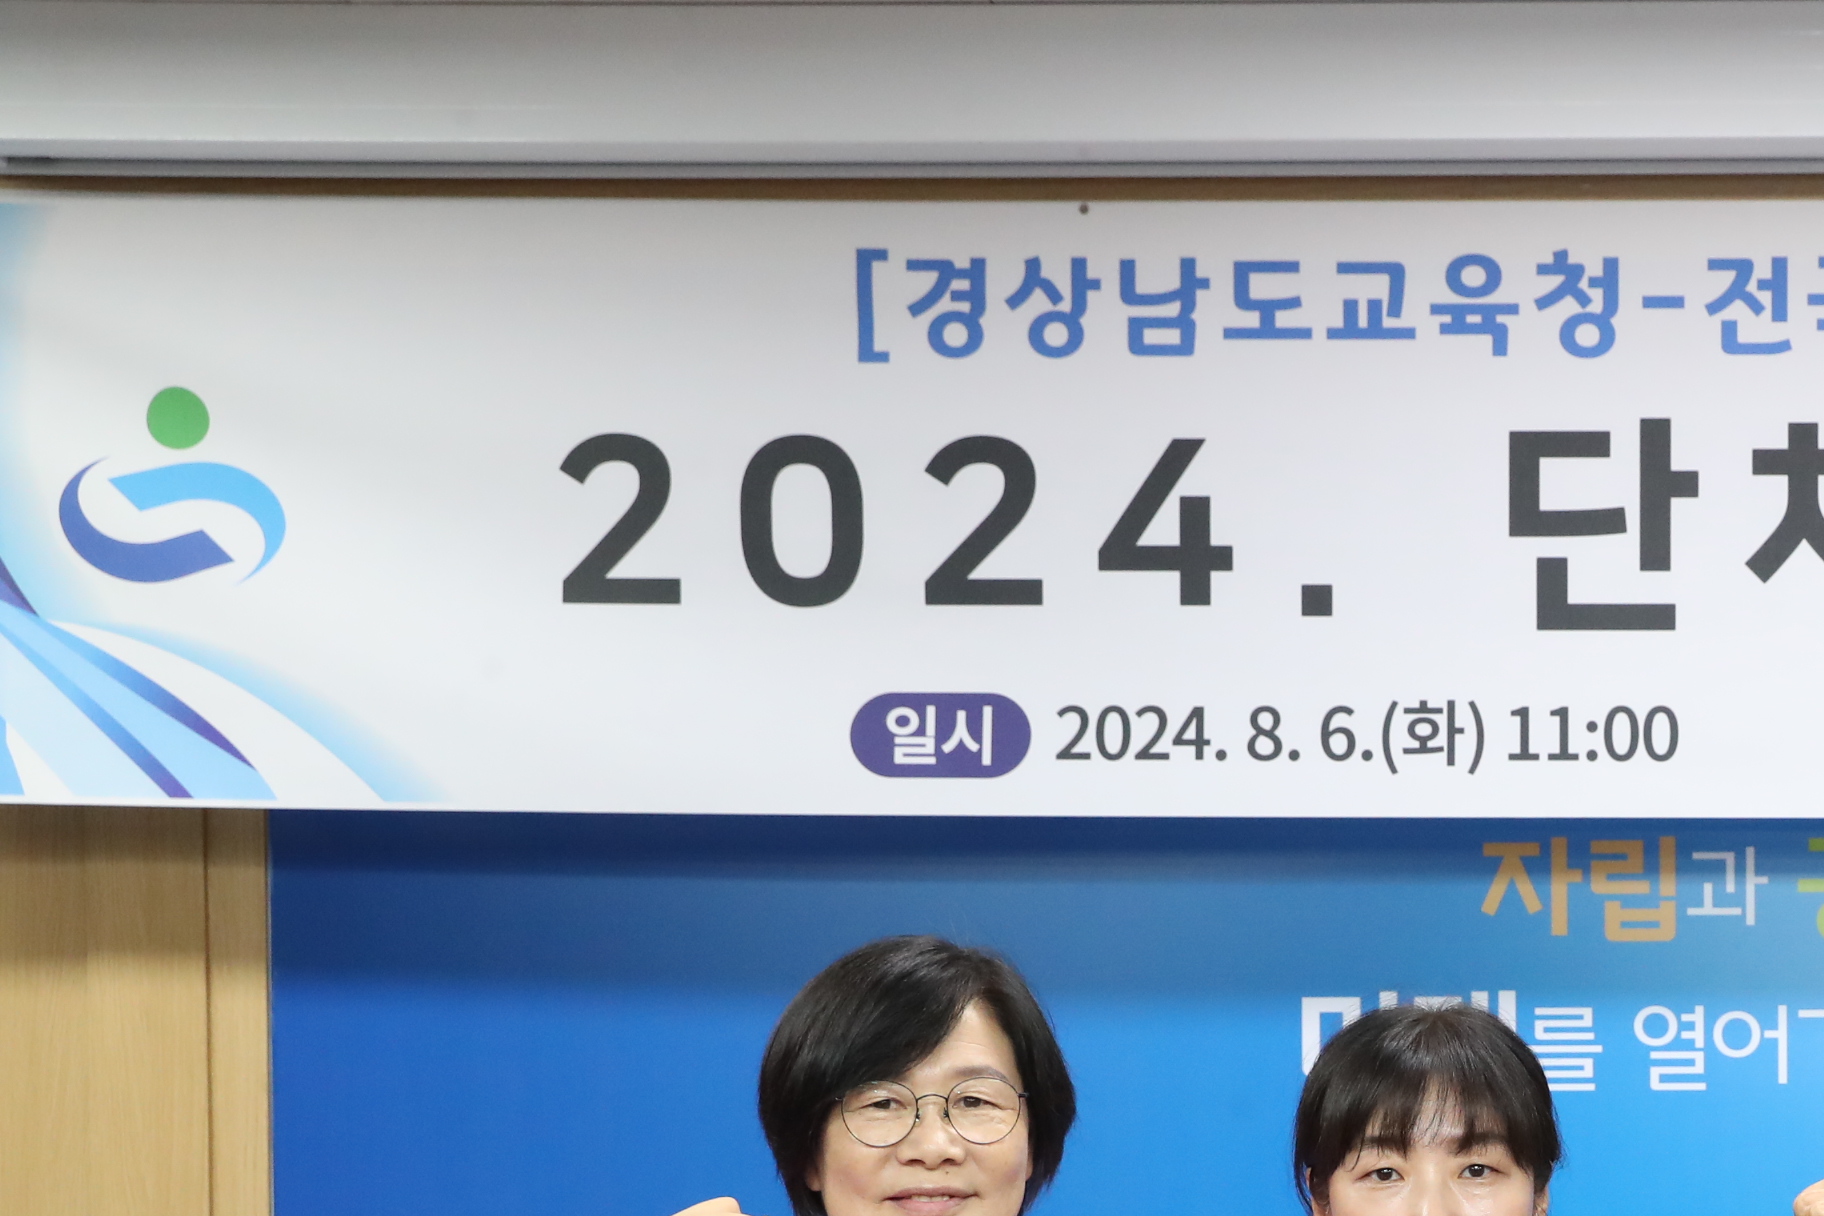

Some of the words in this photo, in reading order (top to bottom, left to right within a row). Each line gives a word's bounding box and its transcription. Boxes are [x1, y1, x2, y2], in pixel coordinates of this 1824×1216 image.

[559, 433, 1333, 617] 2024.
[884, 705, 993, 766] 일시
[1055, 704, 1228, 762] 2024.
[1246, 705, 1301, 763] 8.
[1319, 700, 1485, 775] 6.(화)
[1507, 704, 1680, 763] 11:00
[1481, 836, 1768, 942] 자립과
